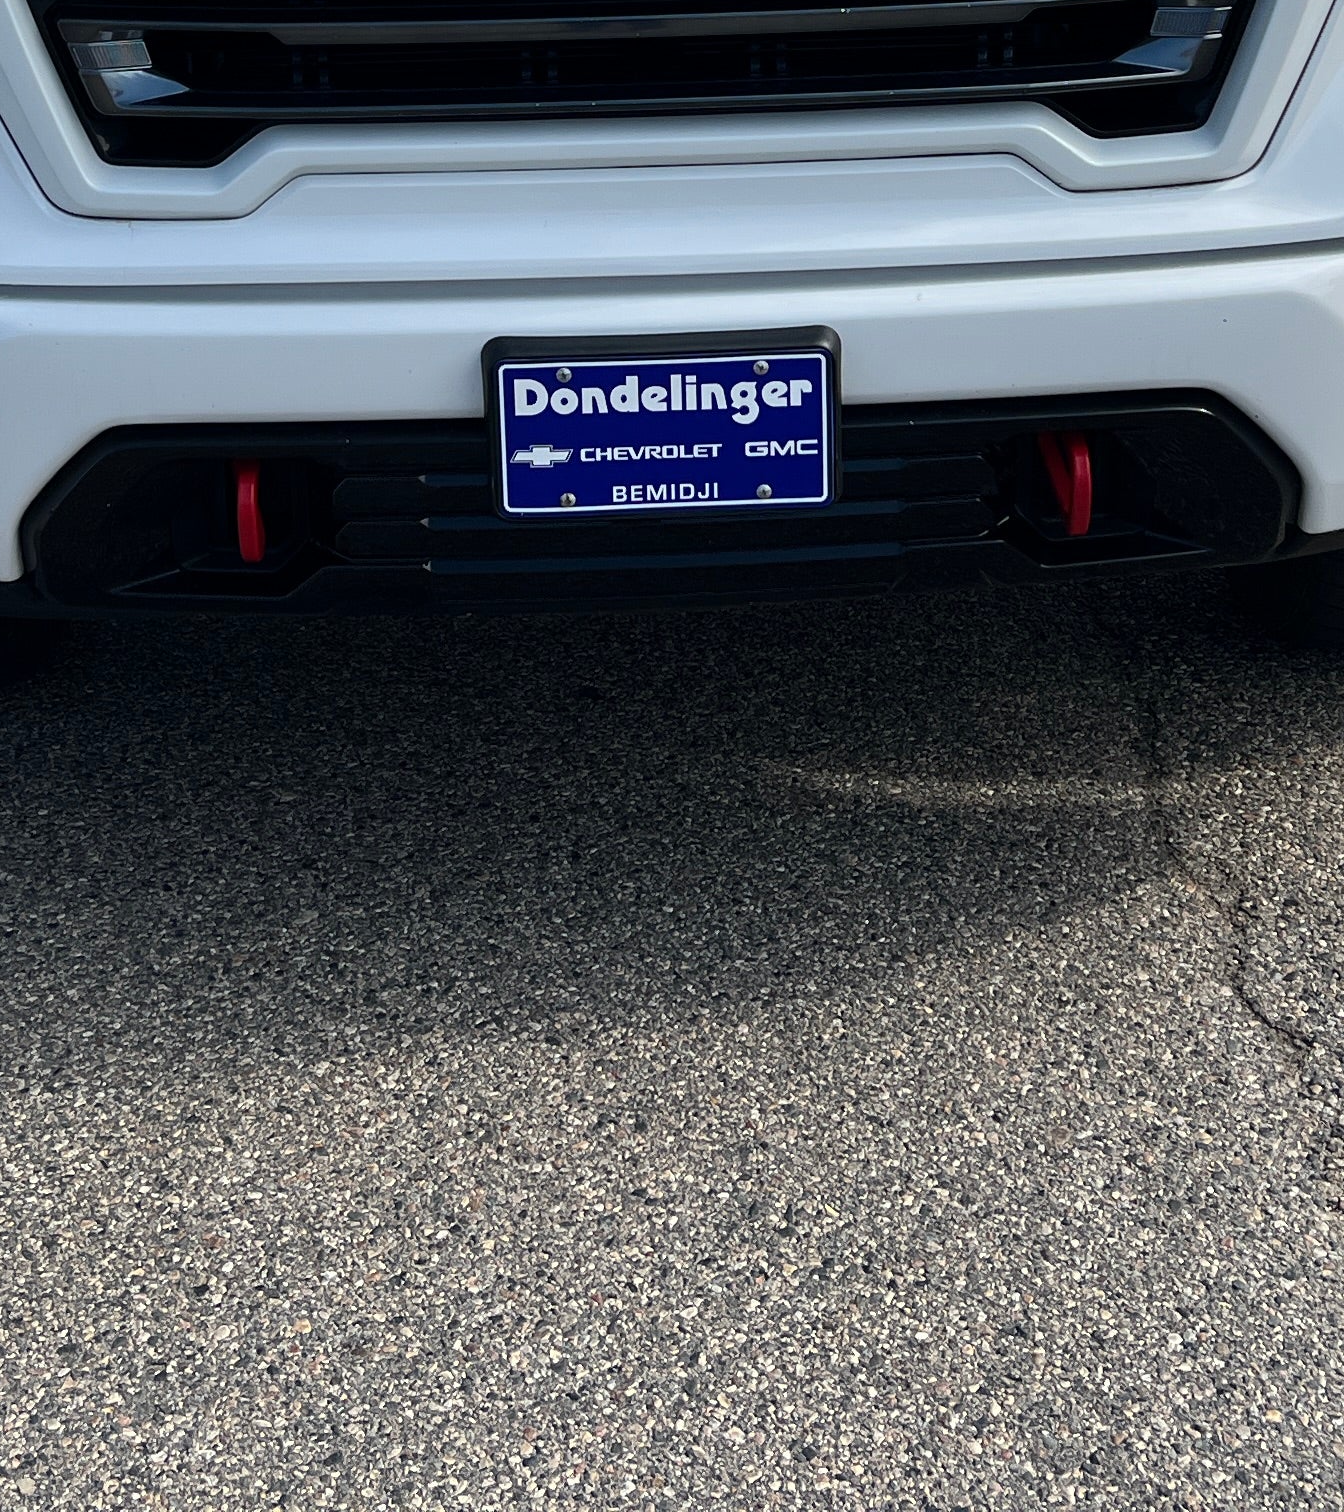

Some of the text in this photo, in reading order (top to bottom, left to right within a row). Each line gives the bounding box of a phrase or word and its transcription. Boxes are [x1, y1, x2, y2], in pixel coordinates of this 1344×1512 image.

[513, 374, 813, 425] Dondelinger
[579, 439, 819, 462] CHEVROLET GMC
[612, 482, 720, 503] BEMIDJI
